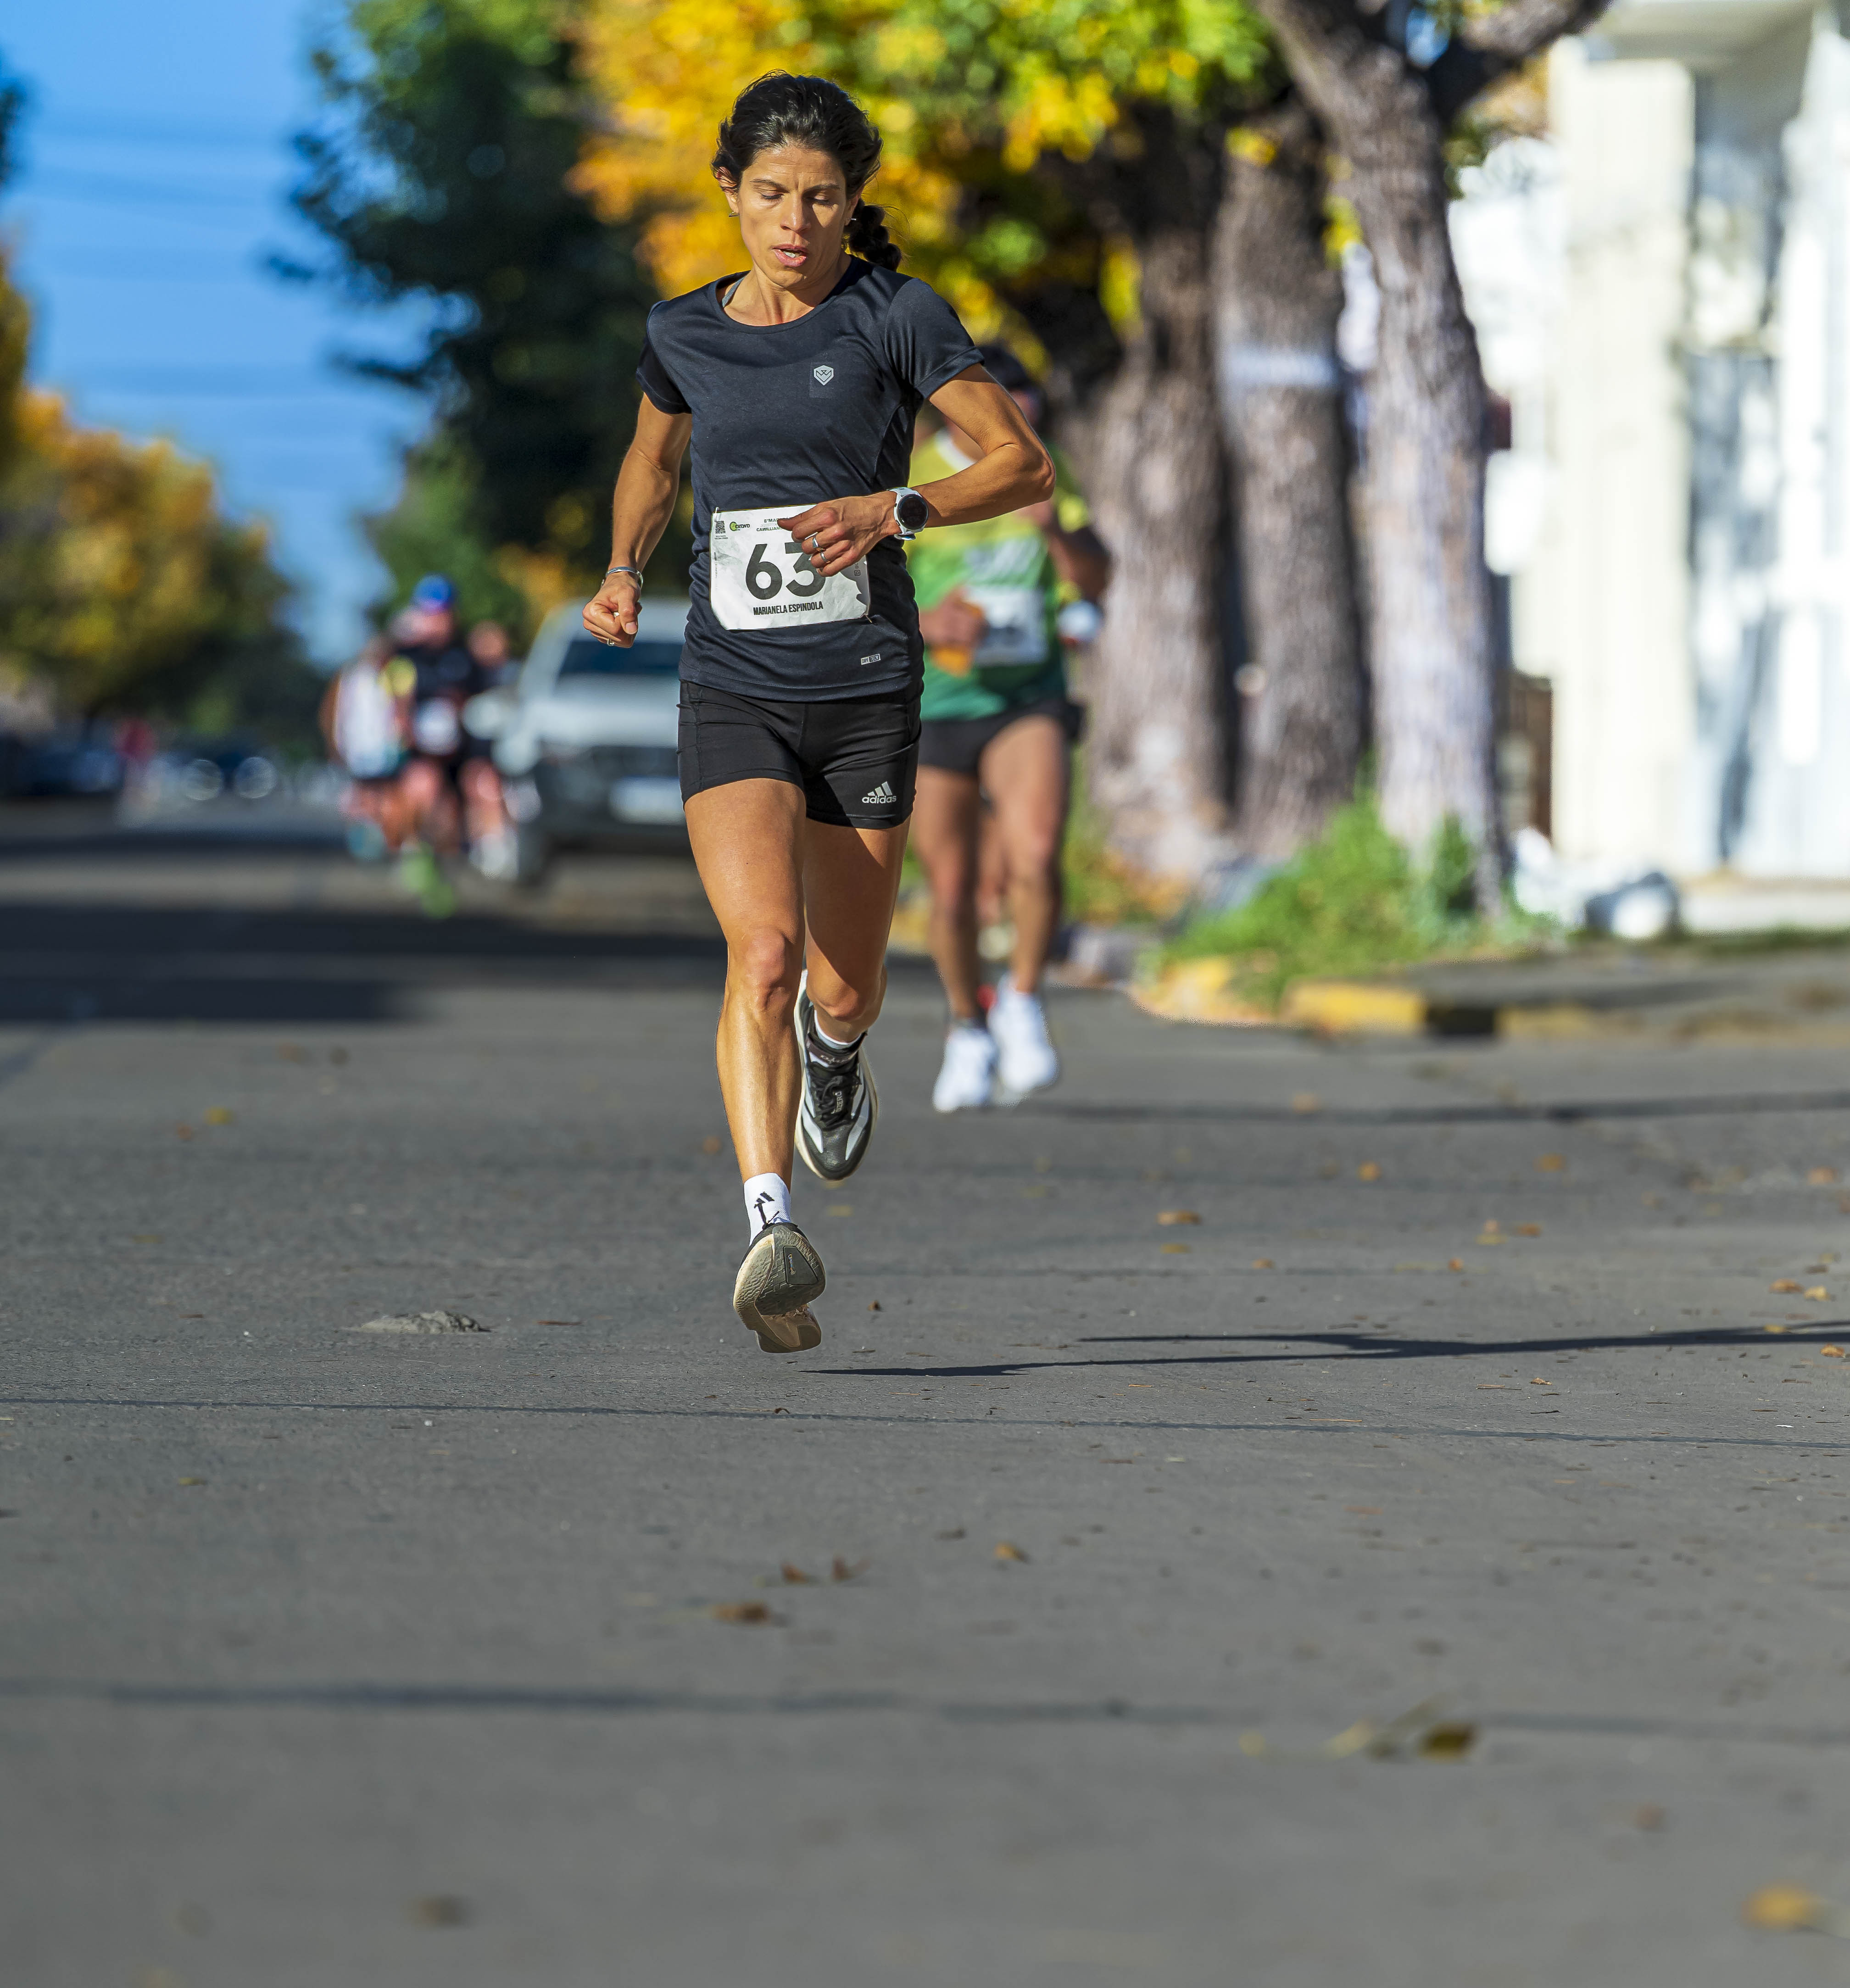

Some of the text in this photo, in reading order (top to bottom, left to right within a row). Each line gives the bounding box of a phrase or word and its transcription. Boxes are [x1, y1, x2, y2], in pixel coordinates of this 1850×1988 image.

[746, 542, 826, 600] 63
[753, 601, 824, 615] MARIANELA ESPINDOLA
[862, 795, 897, 804] adidas
